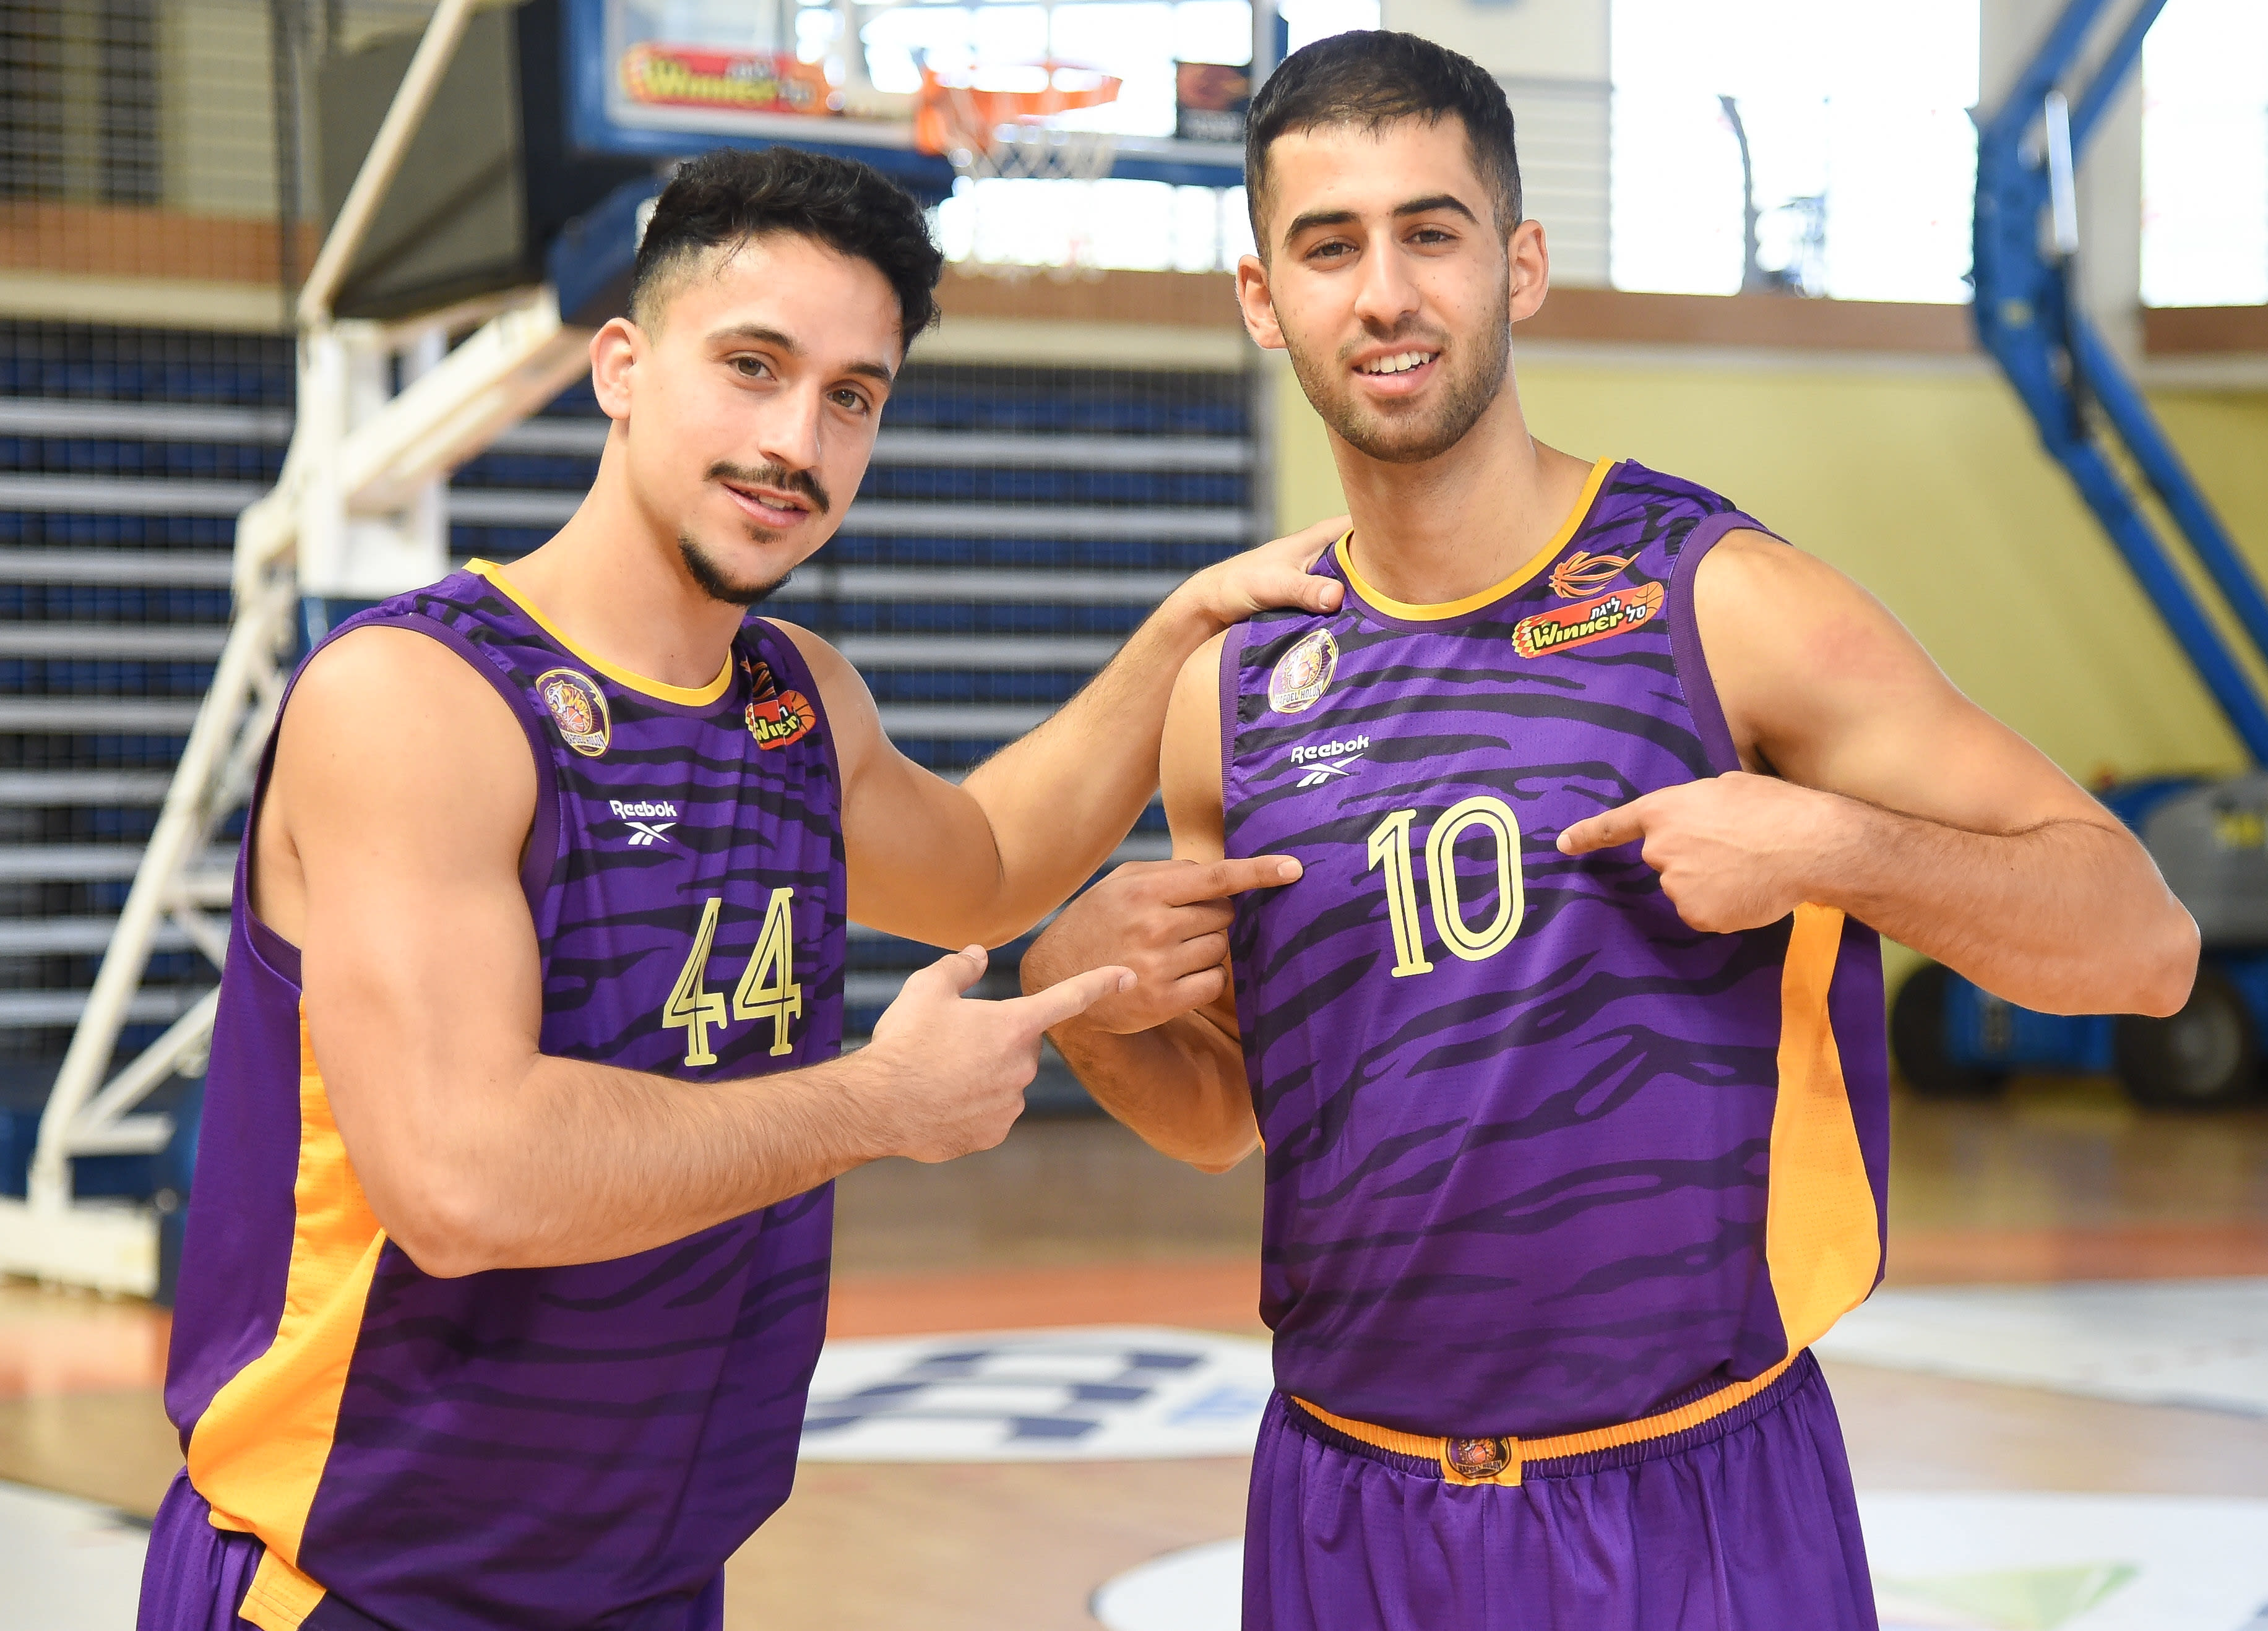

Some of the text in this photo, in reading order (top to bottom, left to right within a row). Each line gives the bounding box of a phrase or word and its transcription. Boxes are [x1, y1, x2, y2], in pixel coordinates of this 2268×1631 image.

[1590, 596, 1621, 620] ליגת
[1626, 605, 1646, 622] סל
[1532, 613, 1624, 648] Winner
[1301, 682, 1322, 699] HOLON
[1290, 734, 1370, 764] Reebok
[609, 800, 678, 820] Reebok
[1367, 795, 1525, 978] 10
[662, 887, 801, 1067] 44
